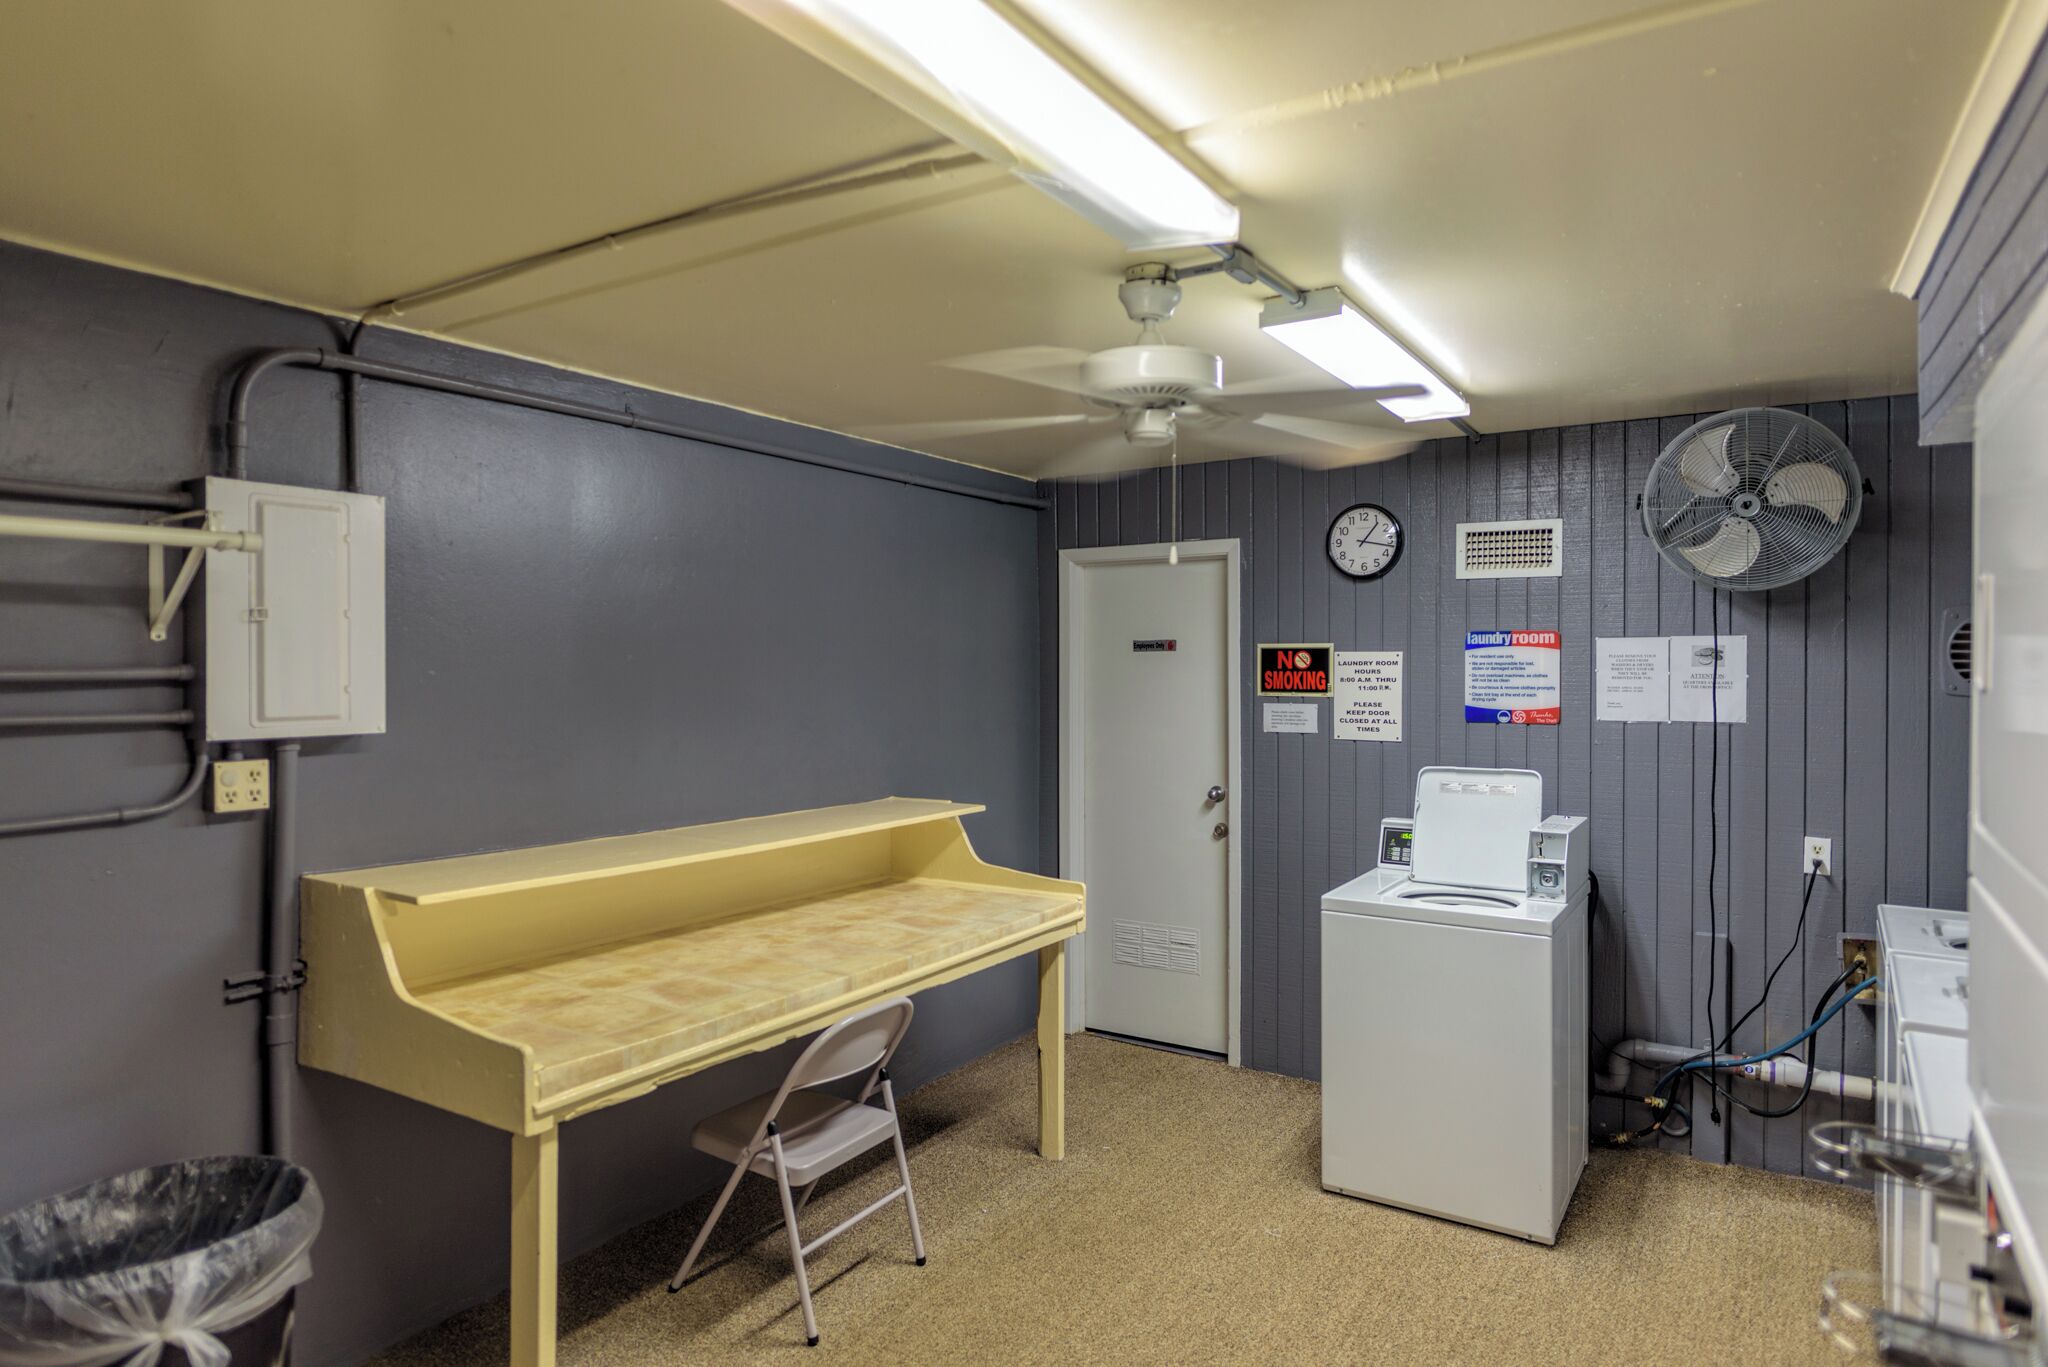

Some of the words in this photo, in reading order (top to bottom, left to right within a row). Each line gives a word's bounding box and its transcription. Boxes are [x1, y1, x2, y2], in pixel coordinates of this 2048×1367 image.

[1348, 516, 1355, 526] 11
[1359, 512, 1369, 522] 12
[1374, 514, 1379, 523] 1
[1339, 526, 1349, 536] 10
[1382, 523, 1389, 533] 2
[1335, 538, 1342, 548] 9
[1386, 535, 1394, 545] 3
[1339, 551, 1346, 561] 8
[1382, 548, 1389, 558] 4
[1348, 559, 1355, 569] 7
[1361, 562, 1368, 572] 6
[1373, 558, 1380, 568] 5
[1511, 632, 1555, 645] room
[1277, 650, 1313, 670] NO
[1264, 670, 1327, 690] SMOKING
